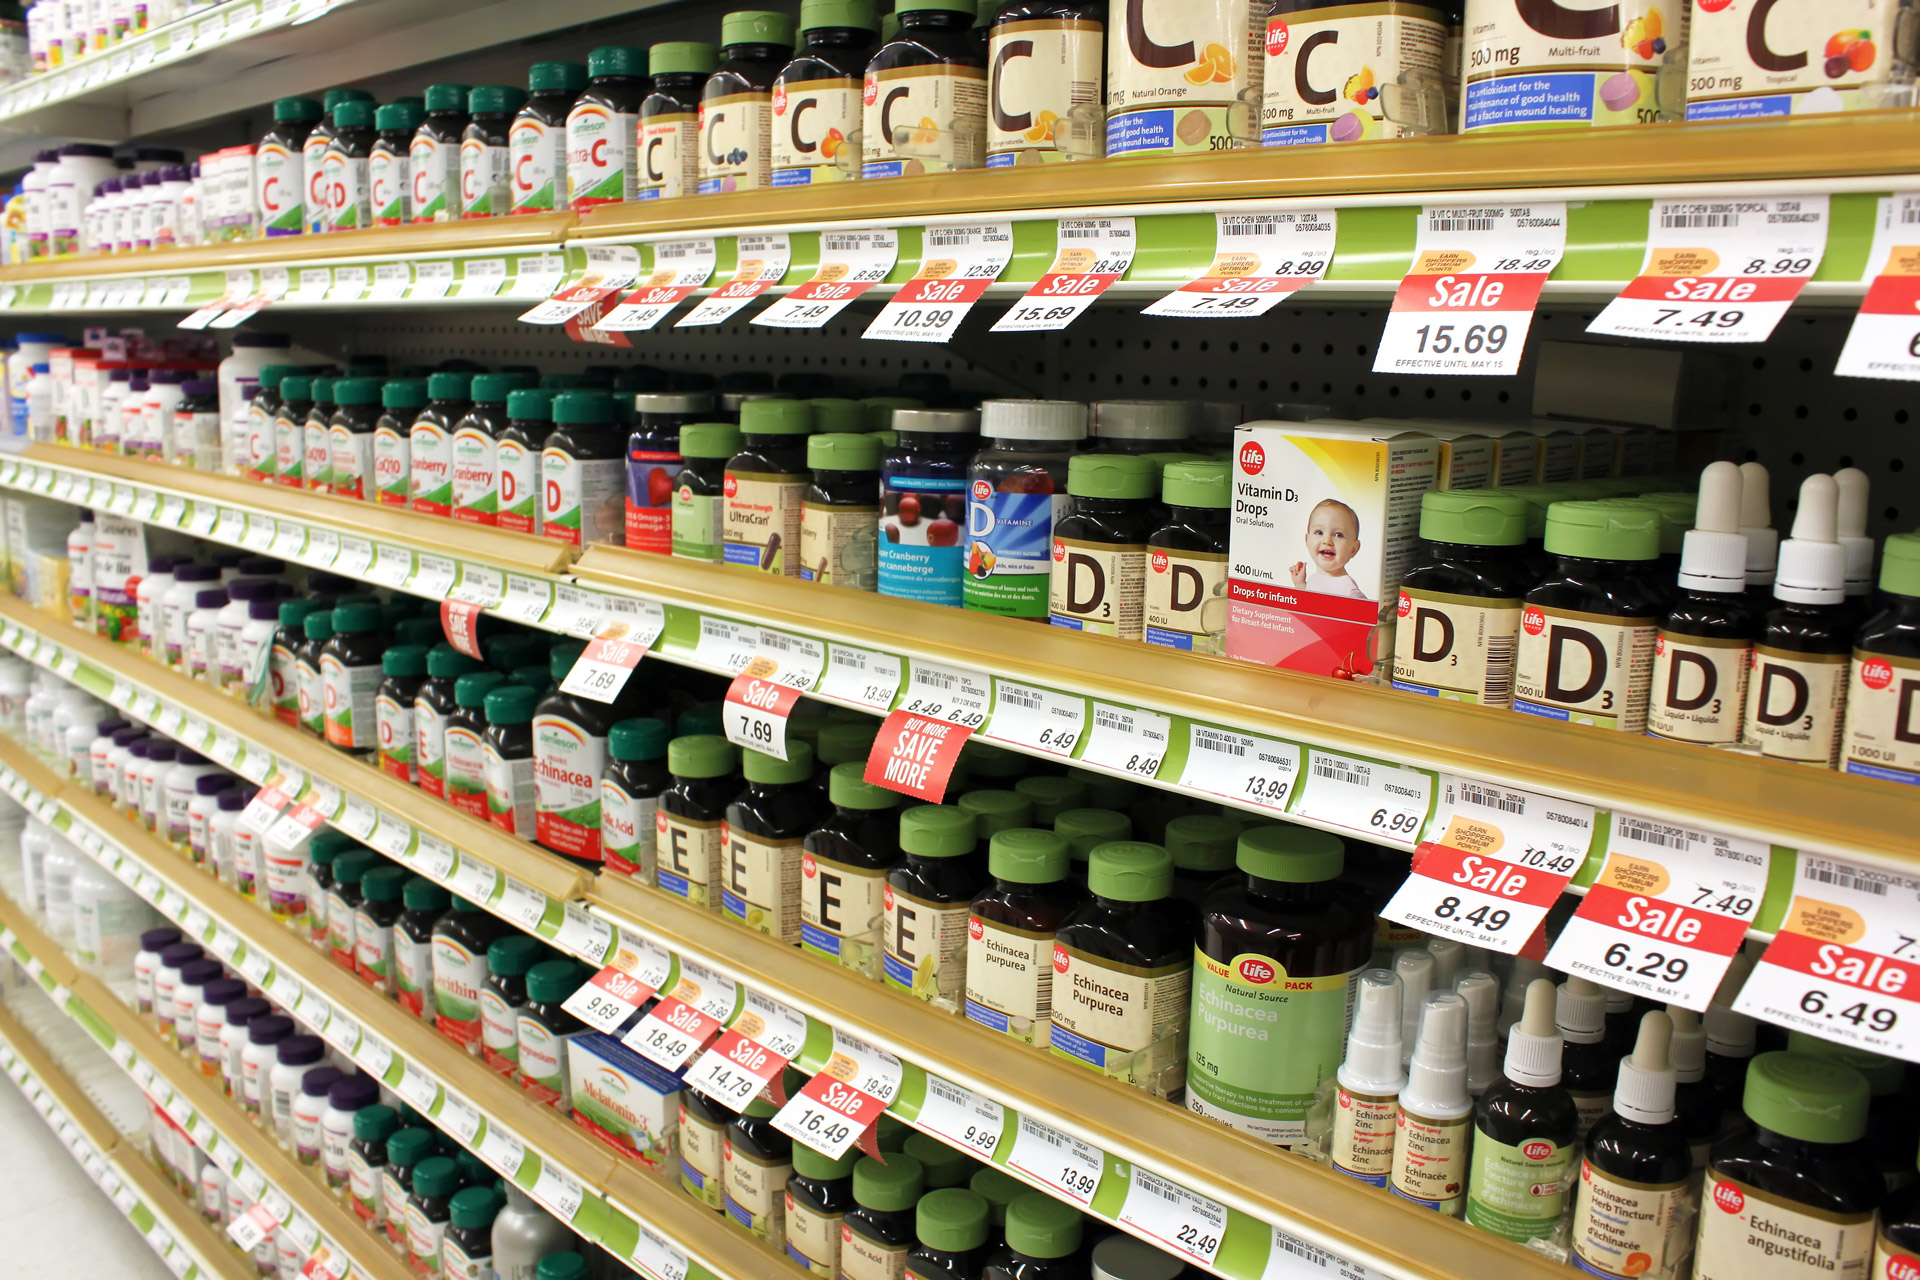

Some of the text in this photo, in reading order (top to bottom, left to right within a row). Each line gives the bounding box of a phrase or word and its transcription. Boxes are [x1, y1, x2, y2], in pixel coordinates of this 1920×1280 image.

[1471, 46, 1521, 67] 500 mg
[1548, 46, 1600, 58] Multi-fruit
[1294, 30, 1339, 105] C
[991, 40, 1034, 132] C
[1132, 87, 1187, 99] Natural Orange
[1476, 84, 1516, 96] antioxidant
[1519, 81, 1531, 91] for
[1534, 81, 1550, 90] the
[1469, 92, 1580, 110] maintenance of good health
[1482, 110, 1503, 120] factor
[1505, 108, 1513, 117] in
[1515, 106, 1547, 116] wound
[1548, 105, 1588, 117] healing
[791, 98, 818, 153] C
[1452, 209, 1504, 219] MULTI-FRUIT 500MG
[963, 264, 1000, 278] 12.99
[1090, 259, 1128, 273] 18.49
[1275, 260, 1325, 275] 8.99
[1493, 258, 1551, 271] 18.49
[1743, 258, 1812, 275] 8.99
[853, 270, 886, 281] 8.99
[1043, 275, 1100, 294] Sale
[1213, 278, 1279, 292] Sale
[640, 288, 679, 304] Sale
[720, 281, 762, 298] Sale
[807, 283, 850, 299] Sale
[915, 280, 966, 300] Sale
[1428, 275, 1504, 307] Sale
[1665, 277, 1757, 300] Sale
[700, 305, 732, 318] 7.49
[785, 305, 827, 318] 7.49
[1014, 306, 1076, 320] 15.69
[1192, 297, 1259, 309] 7.49
[621, 308, 659, 323] 7.49
[894, 310, 953, 328] 10.99
[1652, 309, 1744, 328] 7.49
[1416, 324, 1508, 354] 15.69
[1395, 359, 1504, 369] EFFECTIVE UNTIL MAY 15
[1241, 449, 1263, 464] Life
[974, 484, 990, 496] Life
[1238, 482, 1299, 503] Vitamin D3
[969, 501, 996, 537] D
[1236, 500, 1268, 519] Drops
[996, 518, 1033, 527] VITAMINE
[1236, 516, 1274, 529] Oral Solution
[889, 550, 930, 562] Cranberry
[886, 563, 934, 575] canneberge
[1235, 564, 1273, 580] 400 IU/mL
[1171, 564, 1204, 612] D
[1233, 585, 1297, 605] Drops for infants
[1232, 606, 1292, 623] Dietary Supplement
[1524, 613, 1544, 627] Life
[1241, 617, 1295, 634] Breast-fed Infants
[597, 641, 628, 663] Sale
[1406, 669, 1415, 678] UI
[1545, 624, 1614, 710] D3
[1863, 664, 1890, 680] Life
[584, 669, 616, 689] 7.69
[1666, 649, 1721, 714] D3
[743, 680, 779, 709] Sale
[863, 685, 892, 702] 13.99
[1516, 684, 1534, 697] 1000
[1757, 663, 1813, 731] D3
[908, 700, 983, 726] 8.49 6.49
[1664, 710, 1719, 725] Liquid Liquide
[741, 716, 772, 743] 7.69
[904, 718, 951, 738] BUY MORE
[893, 731, 943, 765] SAVE
[1039, 729, 1075, 749] 6.49
[1126, 755, 1159, 775] 8.49
[1883, 750, 1895, 762] UI
[884, 757, 931, 790] MORE
[1245, 776, 1288, 800] 13.99
[1370, 808, 1418, 833] 6.99
[1468, 825, 1487, 834] EARN
[1546, 812, 1588, 829] 05780084014
[1455, 834, 1490, 848] OPTIMUM
[1456, 828, 1496, 843] SHOPPERS
[670, 827, 690, 875] E
[1457, 841, 1481, 852] POINTS
[731, 839, 747, 896] E
[1520, 847, 1575, 873] 10.49
[1453, 856, 1527, 896] Sale
[820, 872, 841, 931] E
[1692, 887, 1753, 916] 7.49
[1435, 897, 1511, 931] 8.49
[1618, 897, 1702, 943] Sale
[897, 905, 916, 963] E
[1405, 913, 1499, 944] EFFECTIVE UNTIL MAY
[987, 939, 1029, 960] Echinacea
[986, 953, 1026, 972] purpurea
[1207, 961, 1229, 978] VALUE
[1242, 962, 1274, 980] Life
[1604, 943, 1688, 982] 6.29
[1810, 944, 1907, 993] Sale
[605, 973, 638, 999] Sale
[1074, 974, 1129, 1002] Echinacea
[1225, 984, 1289, 1003] Natural Source
[1285, 982, 1313, 990] PACK
[587, 997, 619, 1020] 9.69
[1073, 990, 1124, 1017] Purpurea
[1199, 983, 1278, 1023] Echinacea
[1800, 990, 1898, 1032] 6.49
[666, 1003, 702, 1033] Sale
[1198, 1003, 1268, 1041] Purpurea
[646, 1028, 687, 1057] 18.49
[729, 1038, 767, 1071] Sale
[1196, 1051, 1219, 1076] 125 mg
[708, 1065, 753, 1098] 14.79
[583, 1077, 649, 1131] Melatonin-3
[821, 1082, 863, 1115] Sale
[1355, 1119, 1373, 1130] Zinc
[1356, 1109, 1396, 1120] Echinacea
[798, 1109, 849, 1143] 16.49
[964, 1126, 996, 1150] 9.99
[1408, 1141, 1425, 1152] Zinc
[1409, 1130, 1450, 1145] Echinacea
[1352, 1154, 1370, 1165] Zinc
[1484, 1157, 1536, 1179] Echinacea
[1060, 1167, 1095, 1194] 13.99
[1405, 1164, 1447, 1180] Échinacée
[1484, 1168, 1525, 1188] Tincture
[1404, 1177, 1422, 1188] Zinc
[1483, 1179, 1524, 1199] Teinture
[1481, 1189, 1543, 1210] d'échinacée
[1593, 1183, 1638, 1209] Echinacea
[1716, 1187, 1743, 1206] Life
[1591, 1195, 1655, 1222] Herb Tincture
[1590, 1214, 1625, 1237] Teinture
[1750, 1214, 1822, 1250] Echinacea
[1176, 1224, 1217, 1254] 22.49
[1587, 1225, 1640, 1252] d'échinacée
[1747, 1233, 1835, 1271] angustifolia
